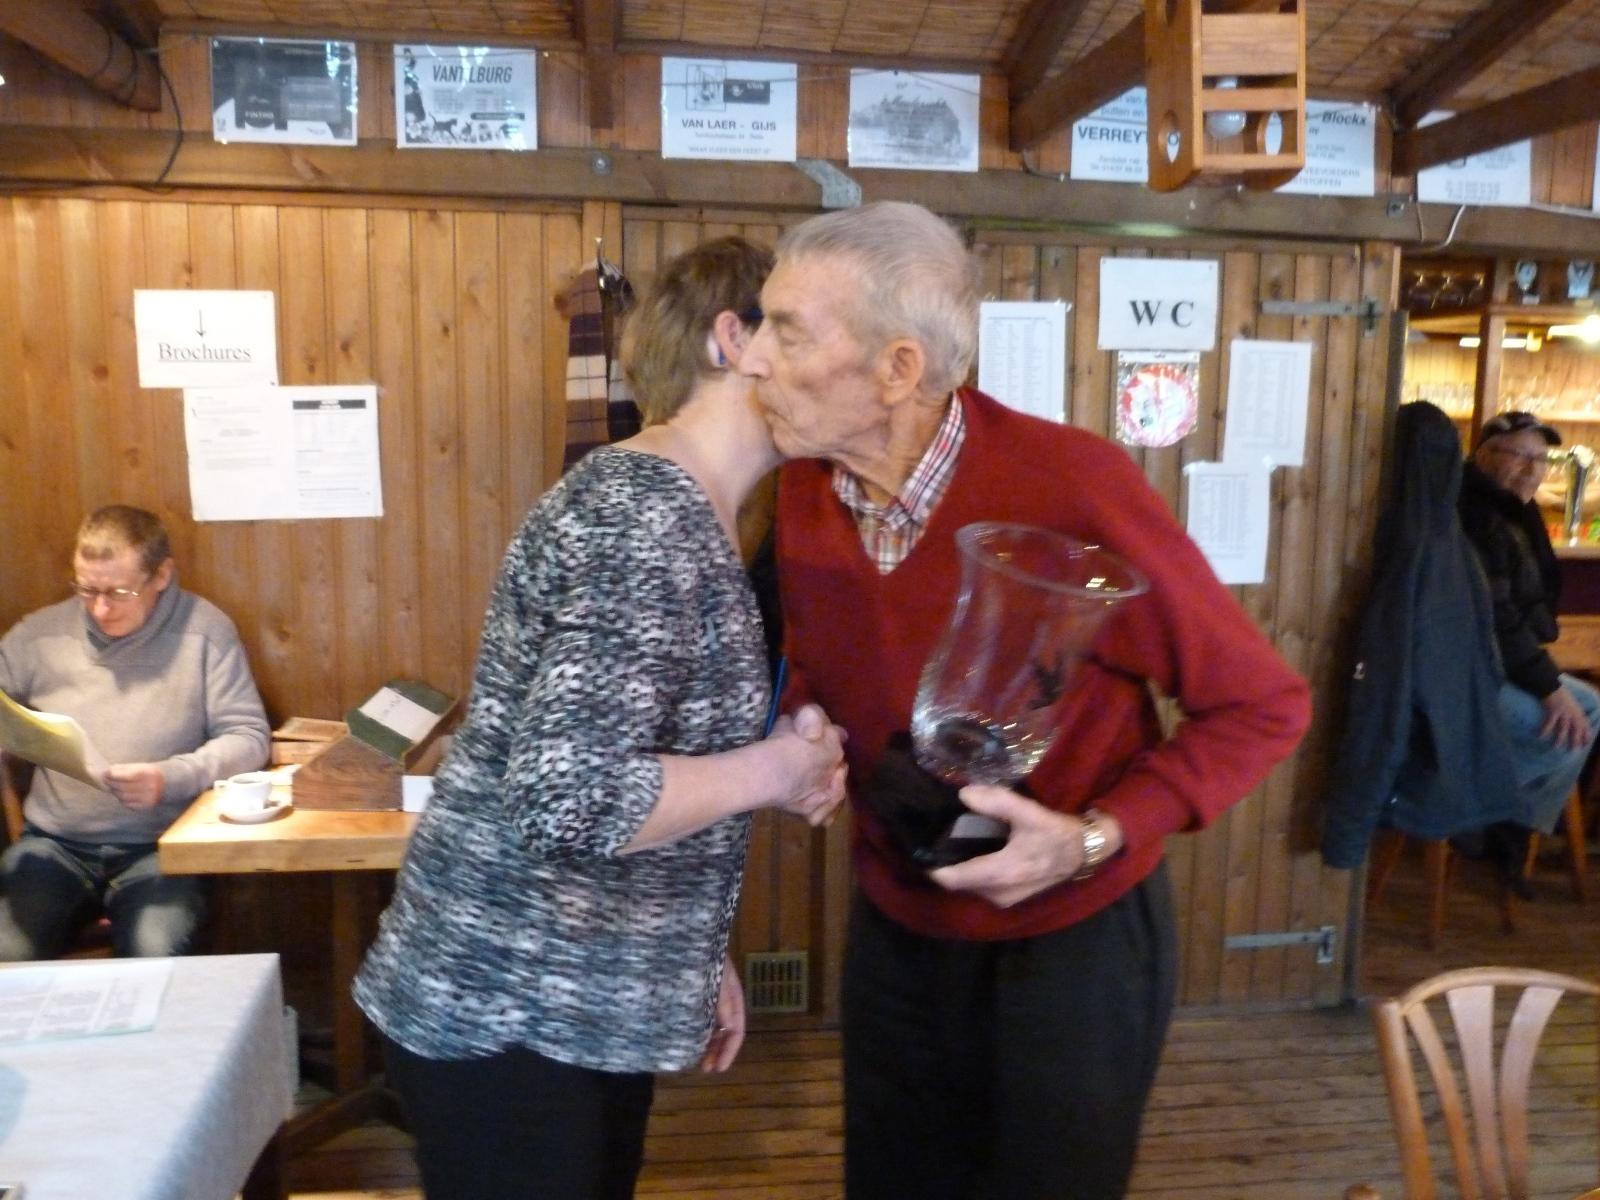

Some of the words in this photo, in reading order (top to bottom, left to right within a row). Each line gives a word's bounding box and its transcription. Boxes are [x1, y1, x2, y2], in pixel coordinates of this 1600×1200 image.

[432, 65, 513, 84] VANTLBURG
[681, 118, 704, 129] VAN
[707, 119, 737, 130] LAER
[1322, 110, 1367, 126] Blockx
[158, 342, 251, 361] Brochures
